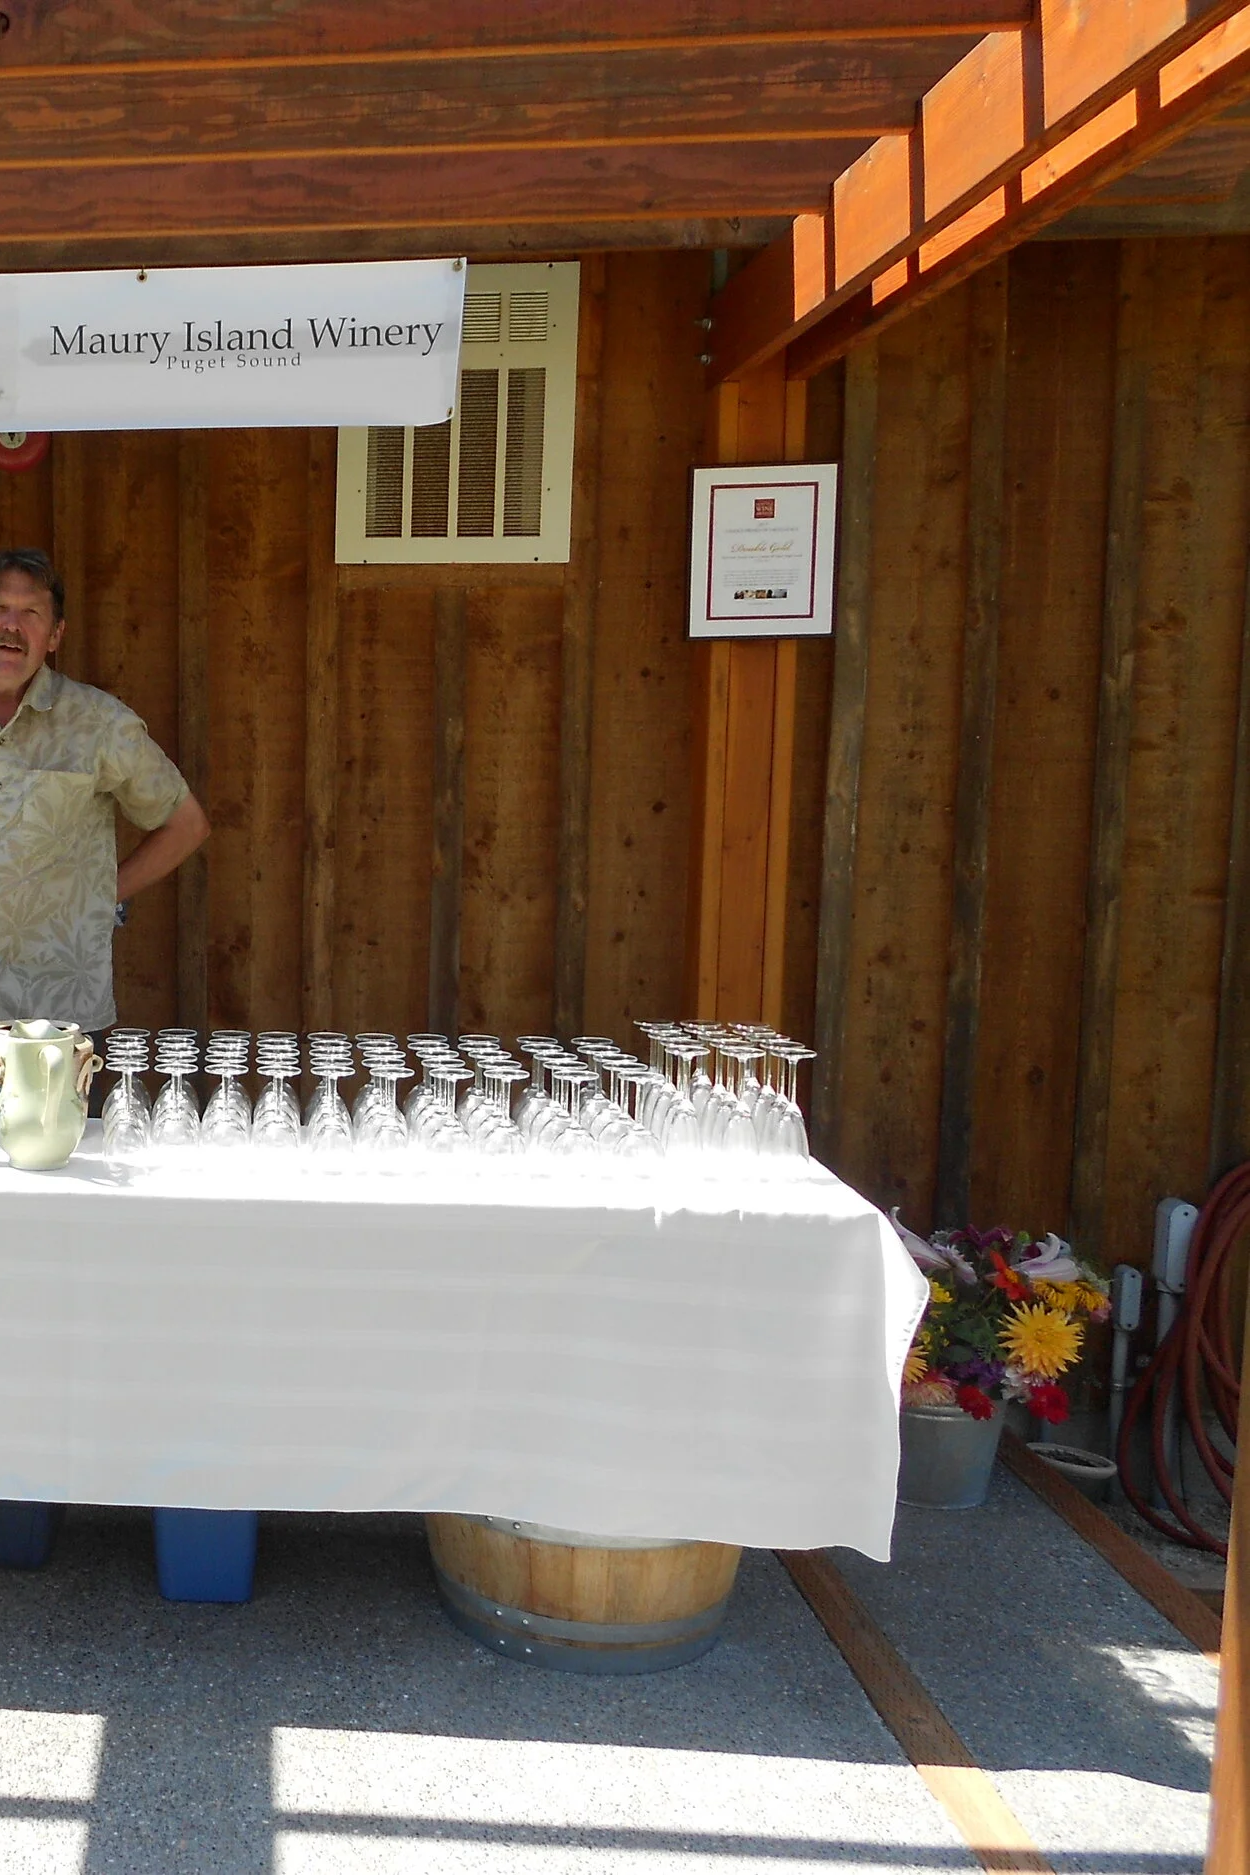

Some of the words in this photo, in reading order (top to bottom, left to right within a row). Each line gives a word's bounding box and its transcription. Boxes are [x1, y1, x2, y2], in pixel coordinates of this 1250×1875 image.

[50, 324, 171, 364] Maury
[183, 318, 294, 352] Island
[307, 316, 445, 356] Winery
[166, 355, 226, 374] Puget
[236, 352, 301, 368] Sound
[770, 541, 794, 553] Gold
